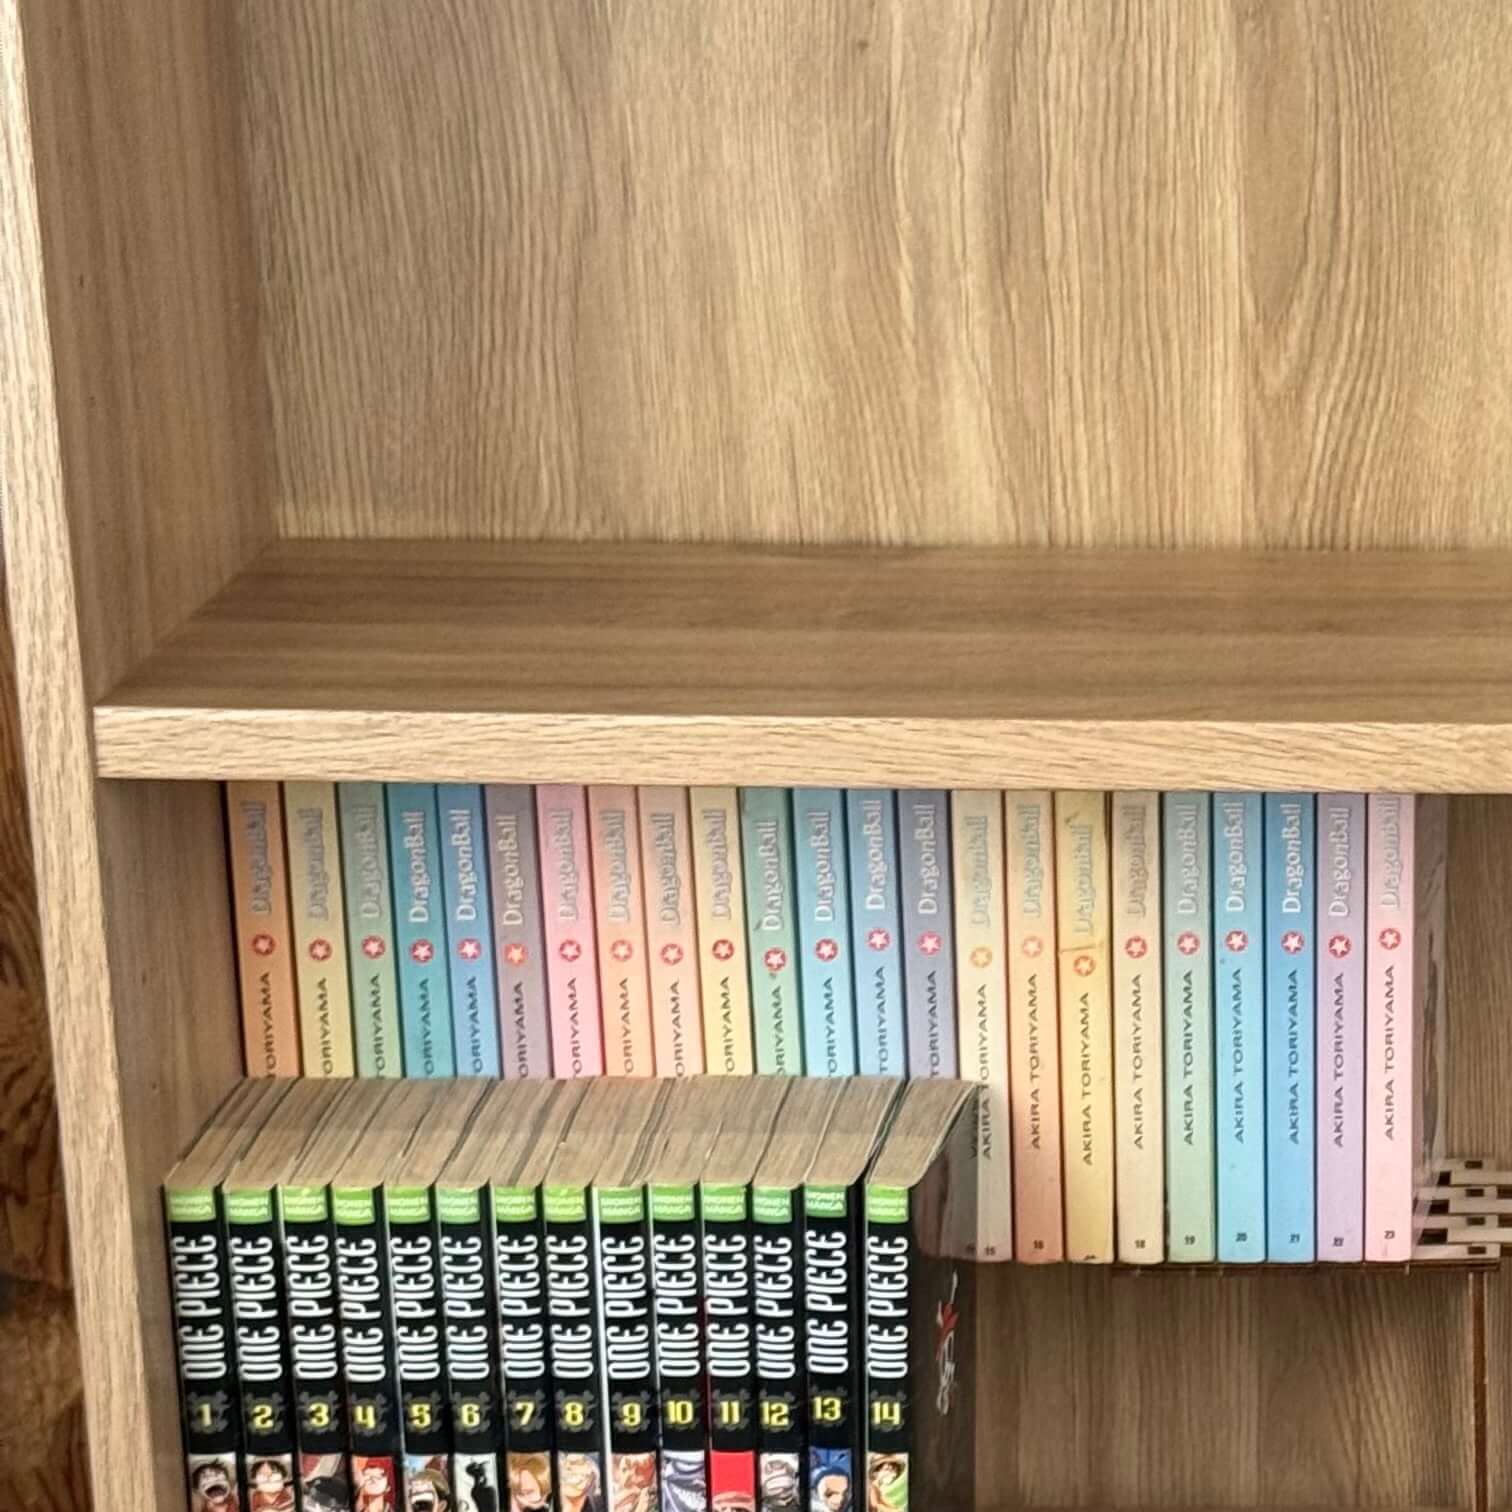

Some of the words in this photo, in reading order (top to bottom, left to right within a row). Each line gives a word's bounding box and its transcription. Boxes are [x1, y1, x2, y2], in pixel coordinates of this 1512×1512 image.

[1026, 974, 1039, 1083] TORIYAMA
[1080, 992, 1092, 1098] TORIYAMA
[1132, 974, 1143, 1081] TORIYAMA
[1182, 970, 1195, 1079] TORIYAMA
[1232, 968, 1245, 1074] TORIYAMA
[1287, 969, 1300, 1076] TORIYAMA
[1333, 972, 1345, 1079] TORIYAMA
[1384, 965, 1397, 1074] TORIYAMA
[981, 1099, 992, 1160] AKIRA
[1030, 1090, 1041, 1149] AKIRA
[1081, 1106, 1092, 1165] AKIRA
[1134, 1091, 1144, 1149] AKIRA
[1183, 1085, 1194, 1146] AKIRA
[1234, 1084, 1244, 1144] AKIRA
[1288, 1083, 1299, 1145] AKIRA
[1334, 1086, 1343, 1148] AKIRA
[1384, 1080, 1394, 1141] AKIRA
[172, 1234, 221, 1318] PIECE
[231, 1237, 277, 1319] PIECE
[286, 1235, 334, 1318] PIECE
[335, 1238, 381, 1320] PIECE
[391, 1236, 436, 1318] PIECE
[442, 1236, 485, 1318] PIECE
[497, 1235, 541, 1317] PIECE
[546, 1235, 590, 1317] PIECE
[602, 1236, 647, 1318] PIECE
[655, 1234, 696, 1316] PIECE
[705, 1235, 748, 1316] PIECE
[754, 1237, 794, 1317] PIECE
[805, 1231, 847, 1312] PIECE
[868, 1236, 908, 1317] PIECE
[177, 1324, 227, 1381] ONE
[237, 1325, 283, 1382] ONE
[293, 1325, 337, 1380] ONE
[342, 1327, 386, 1383] ONE
[397, 1326, 440, 1381] ONE
[446, 1326, 489, 1381] ONE
[502, 1325, 544, 1379] ONE
[551, 1325, 593, 1379] ONE
[607, 1324, 650, 1379] ONE
[659, 1323, 700, 1377] ONE
[707, 1323, 750, 1377] ONE
[757, 1325, 795, 1379] ONE
[807, 1319, 849, 1374] ONE
[868, 1324, 908, 1378] ONE
[200, 1404, 213, 1427] 1
[252, 1405, 274, 1428] 2
[309, 1403, 331, 1426] 3
[354, 1405, 376, 1428] 4
[408, 1404, 431, 1427] 5
[461, 1403, 481, 1427] 6
[515, 1402, 535, 1425] 7
[564, 1402, 585, 1426] 8
[624, 1403, 641, 1424] 9
[667, 1401, 693, 1423] 10
[720, 1402, 740, 1424] 11
[762, 1402, 789, 1426] 12
[813, 1397, 842, 1420] 13
[872, 1403, 900, 1424] 14
